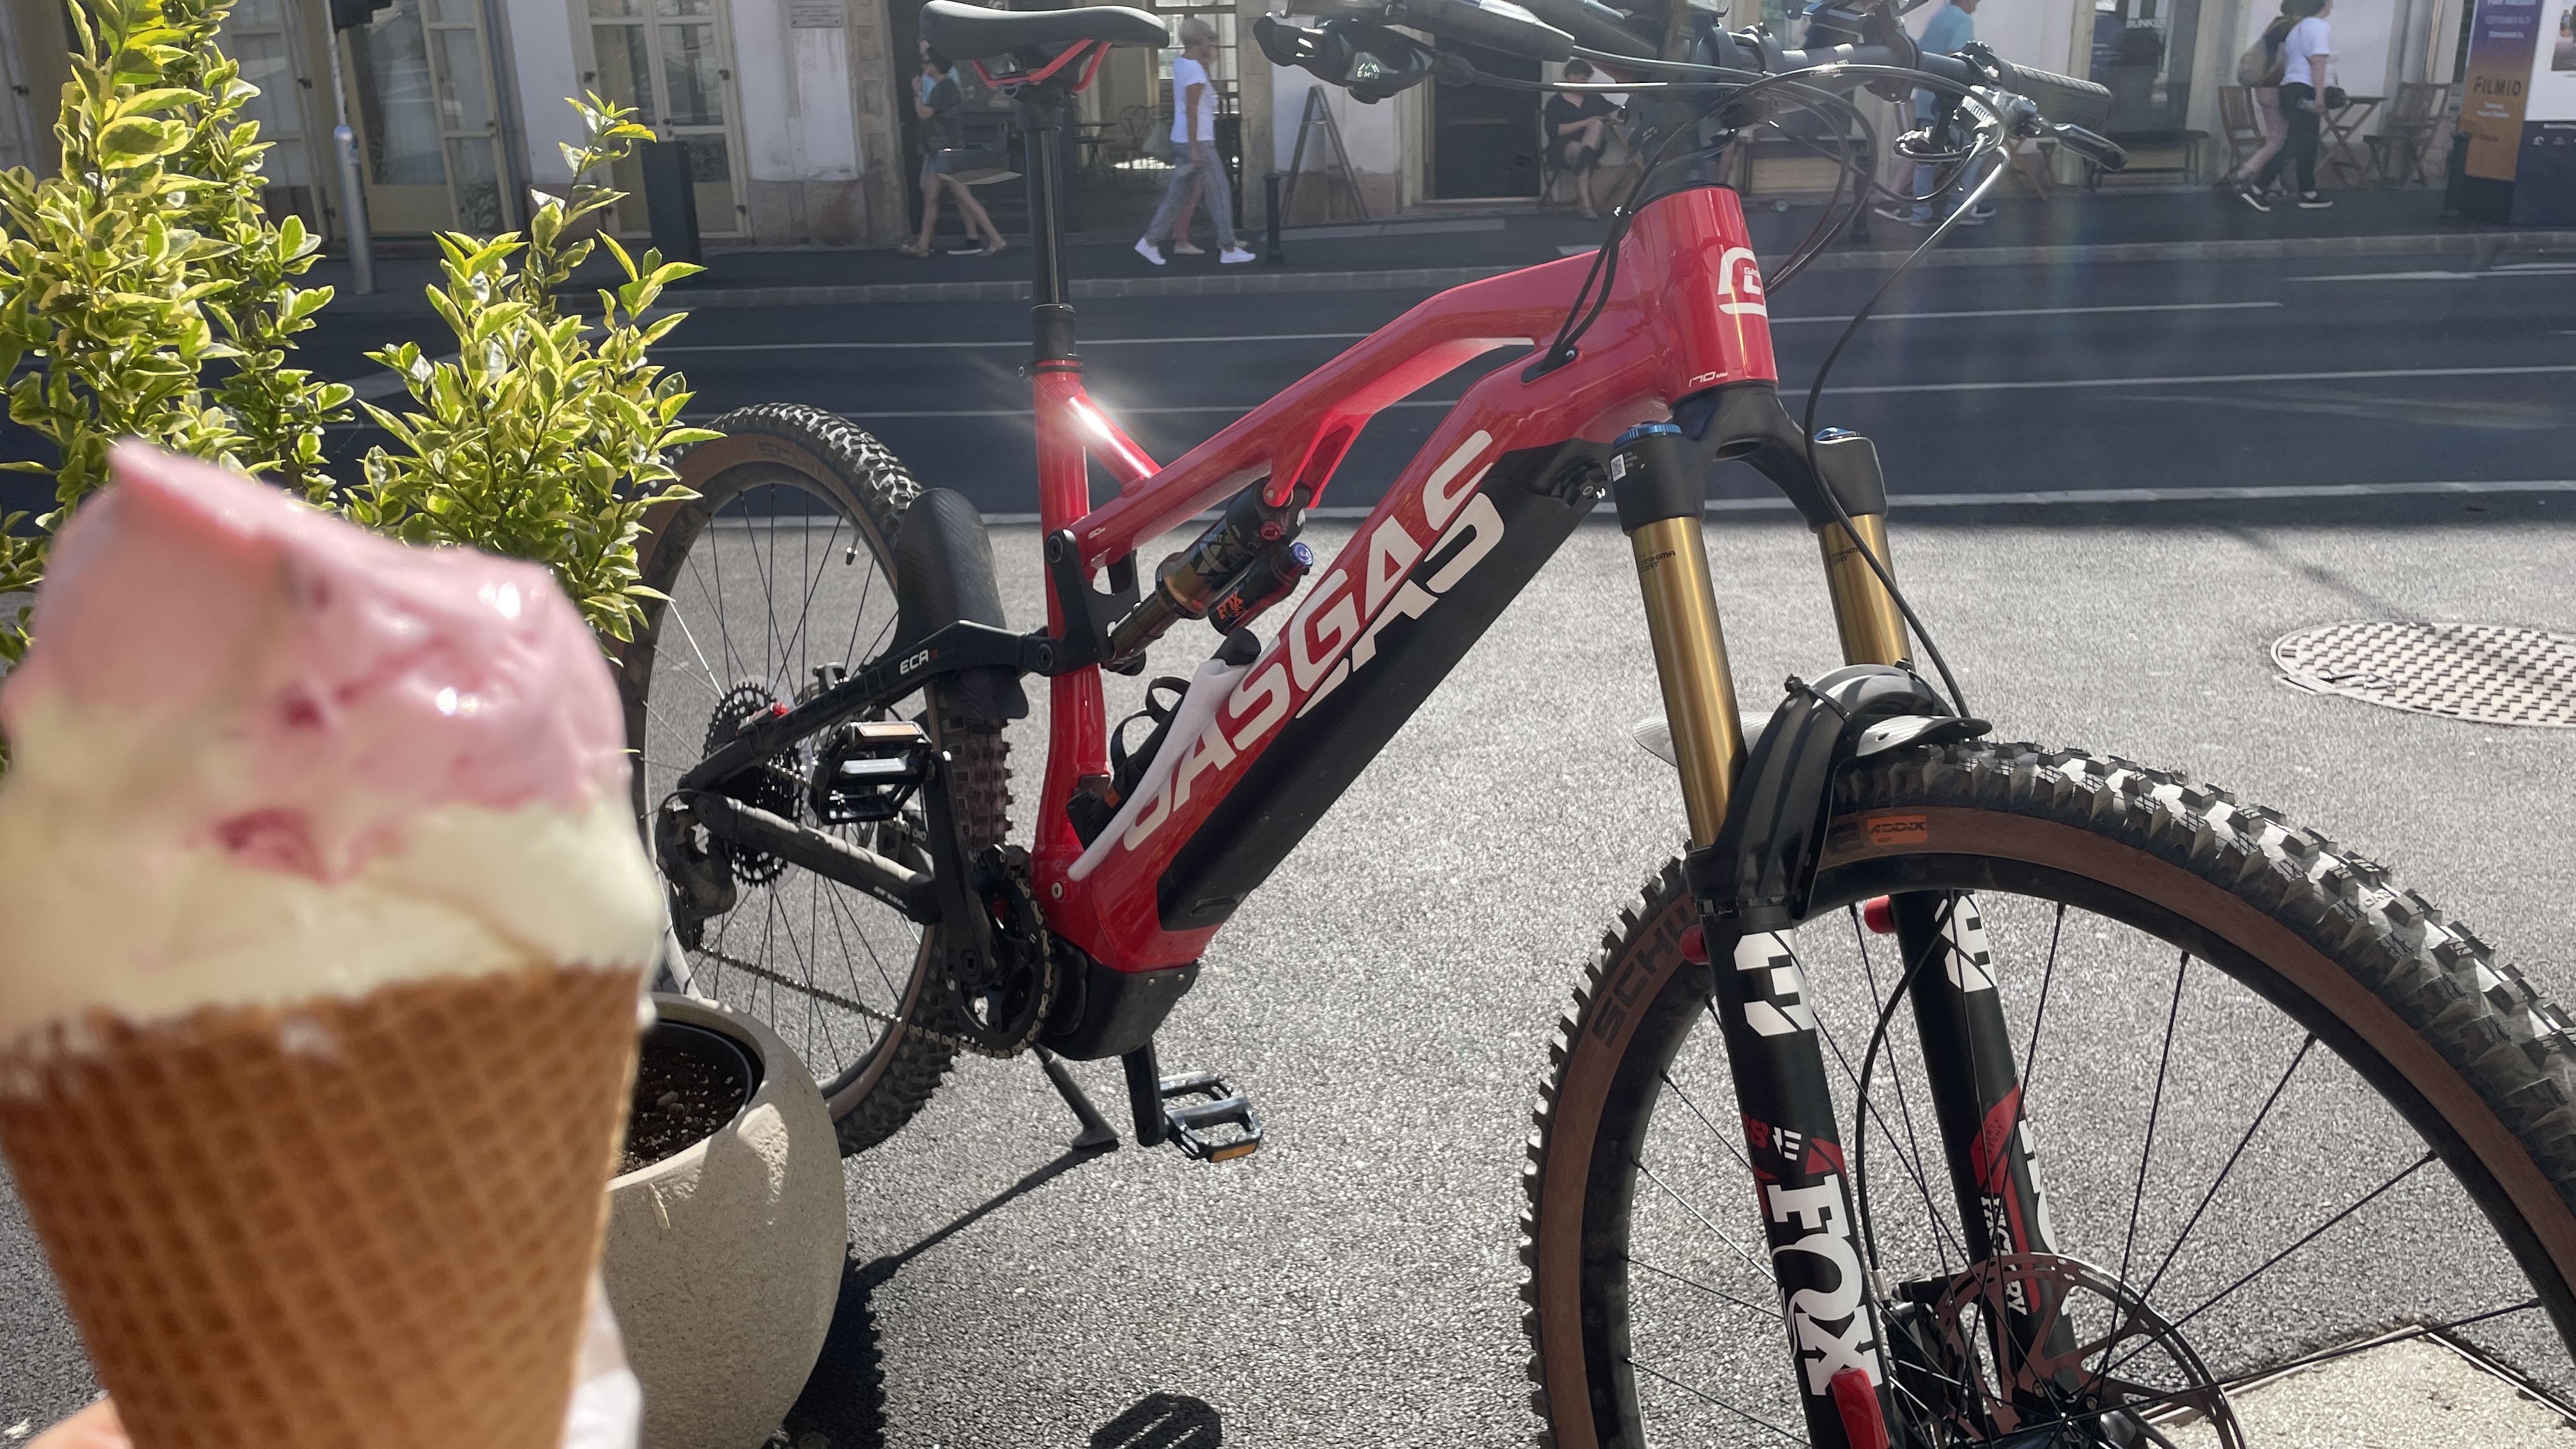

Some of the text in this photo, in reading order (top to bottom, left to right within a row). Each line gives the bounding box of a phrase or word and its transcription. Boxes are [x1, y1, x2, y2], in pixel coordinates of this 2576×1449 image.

[1216, 589, 1244, 620] FOX
[900, 648, 929, 675] ECA
[1733, 928, 1815, 1036] 3
[1767, 1174, 1883, 1396] FOX
